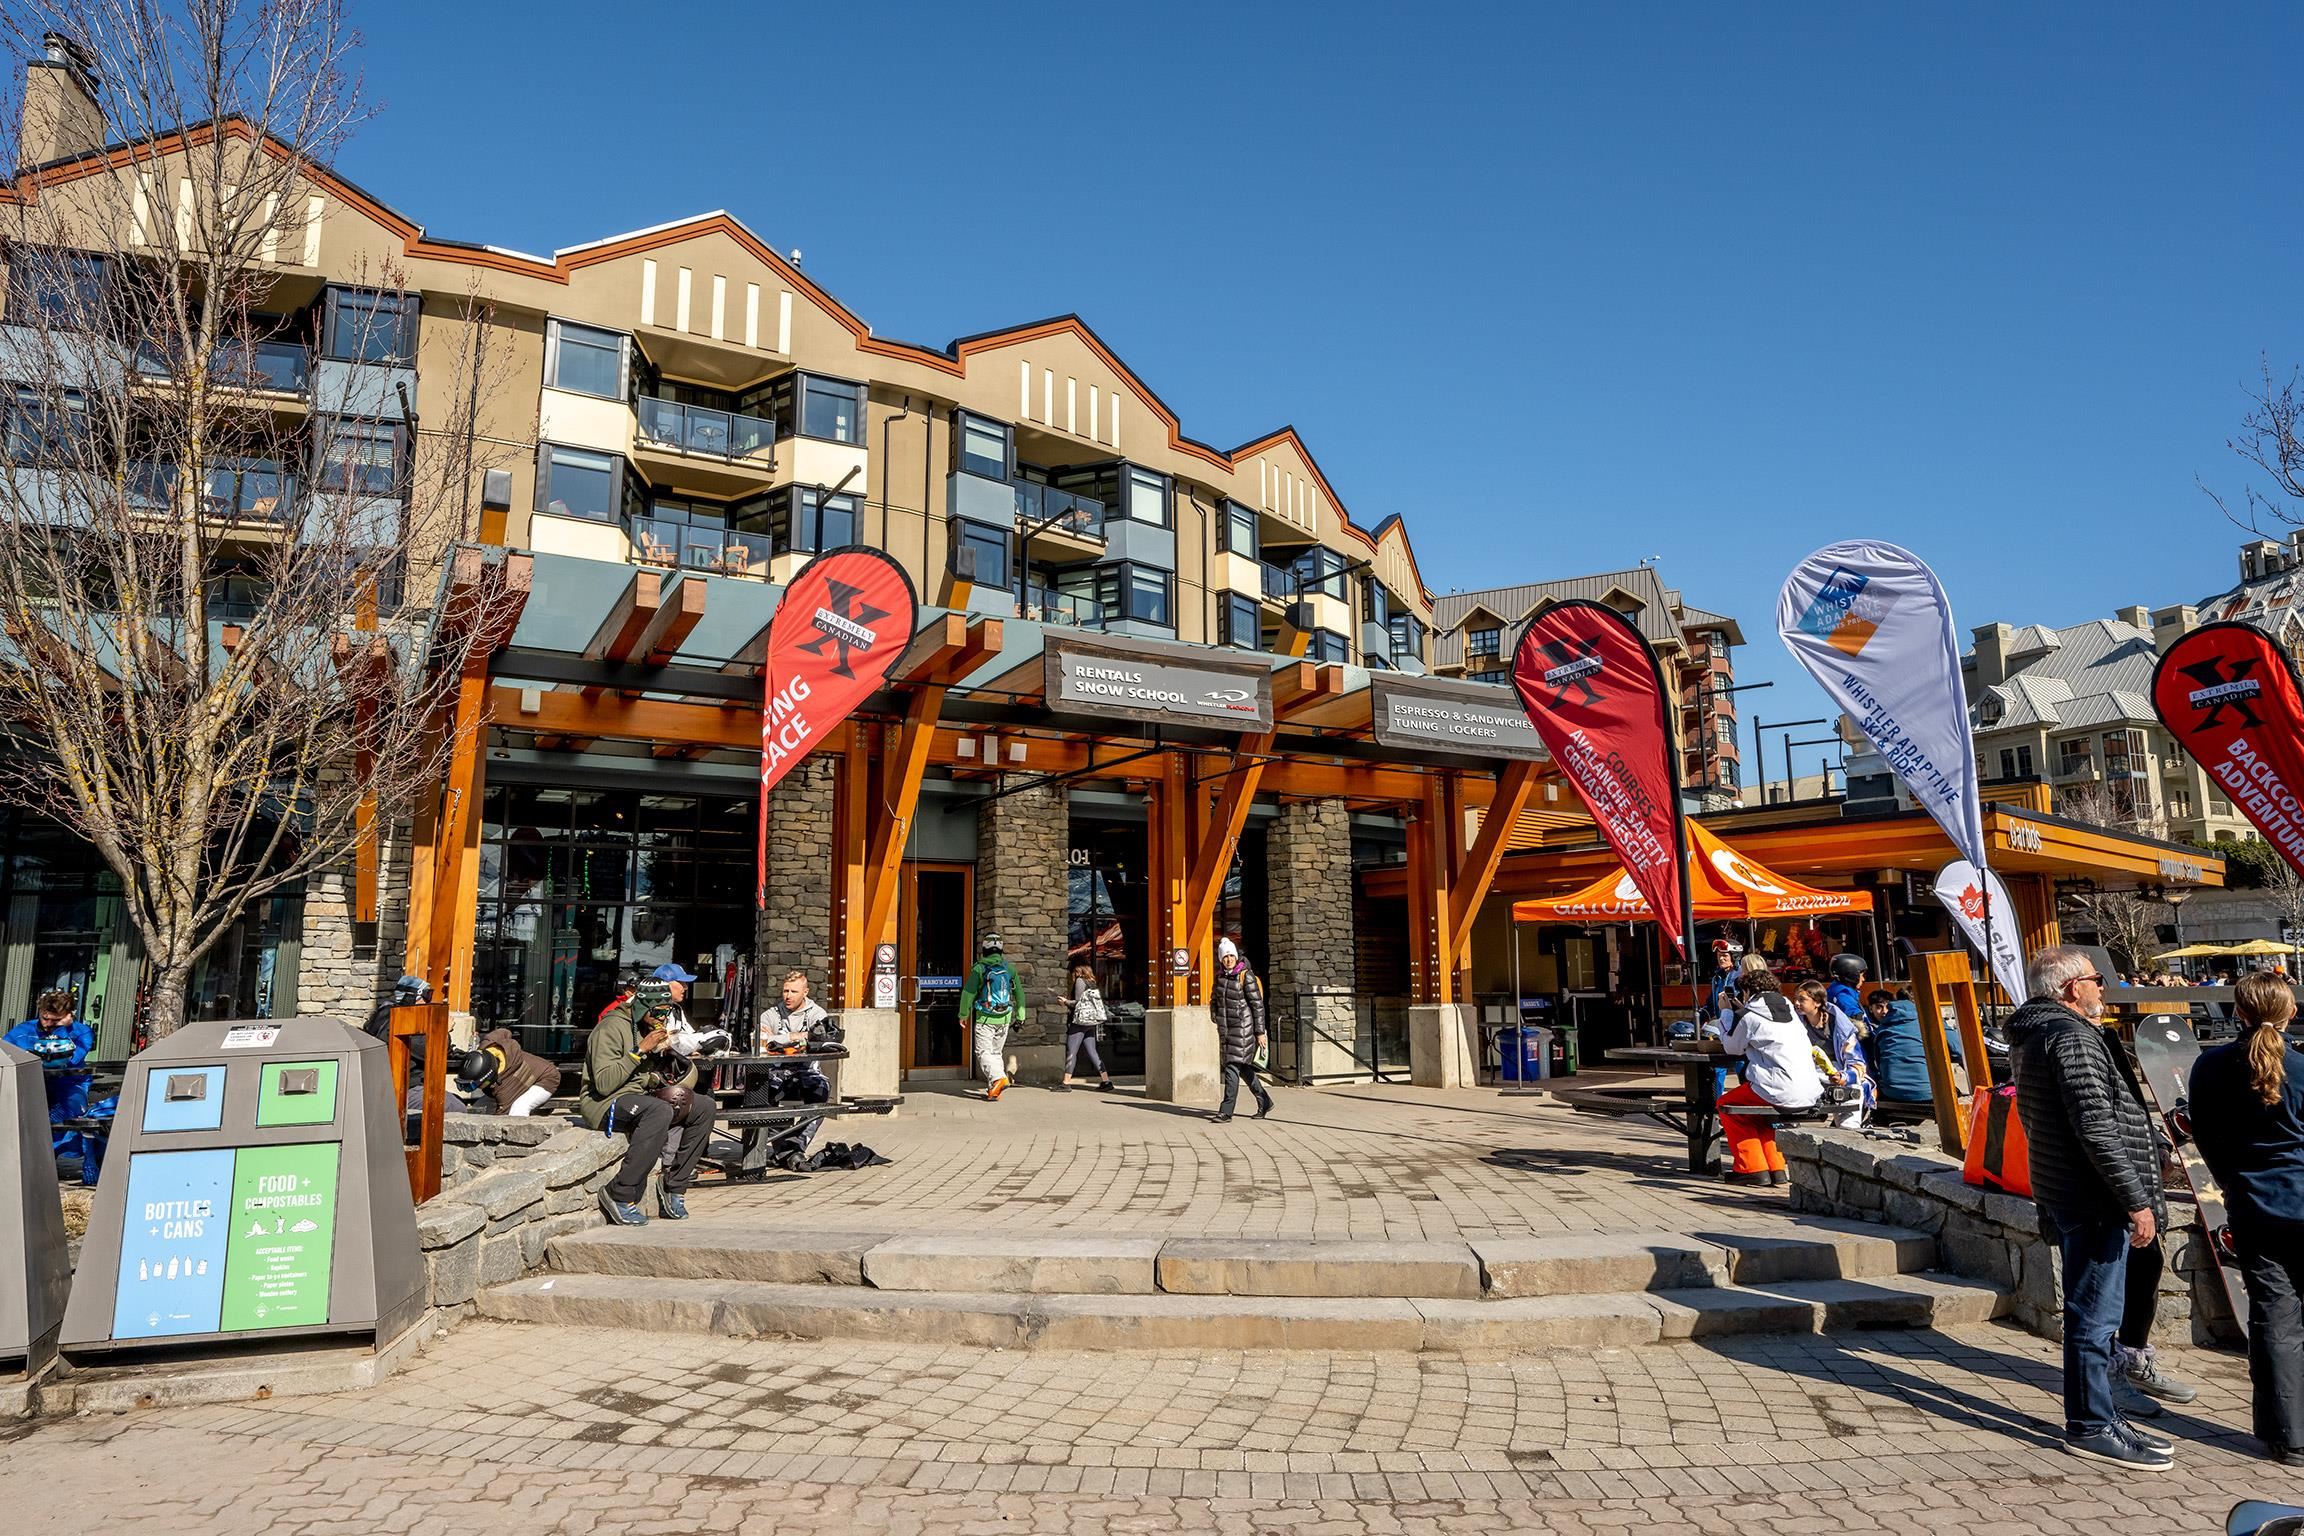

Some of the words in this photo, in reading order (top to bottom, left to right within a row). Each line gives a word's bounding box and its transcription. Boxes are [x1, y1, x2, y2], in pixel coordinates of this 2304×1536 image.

[815, 620, 868, 649] CANADIAN
[817, 610, 874, 640] EXTREMELY
[1075, 666, 1142, 684] RENTALS
[1549, 666, 1600, 688] CANADIAN
[1075, 681, 1124, 698] SNOW
[1128, 687, 1188, 705] SCHOOL
[1394, 704, 1449, 720] ESPRESSO
[1452, 711, 1461, 721] &
[1464, 712, 1534, 730] SANDWICHES
[1394, 718, 1439, 732] TUNING
[1449, 725, 1497, 738] LOCKERS
[1842, 674, 1901, 739] WHISTLER
[1897, 737, 1960, 805] ADAPTIVE
[1860, 716, 1882, 737] SKI
[1877, 736, 1889, 749] &
[1887, 747, 1917, 778] RIDE
[1605, 751, 1656, 818] COURSES
[2227, 738, 2304, 832] BACKCOU
[1564, 744, 1614, 817] CREVASSE
[1608, 813, 1652, 873] RESCUE
[1568, 729, 1631, 813] AVALANCHE
[1625, 810, 1670, 867] SAFETY
[258, 1174, 297, 1194] FOOD
[301, 1177, 311, 1187] +
[145, 1199, 212, 1221] BOTTLES
[245, 1193, 322, 1211] COMPOSTABLES
[150, 1225, 159, 1237] +
[163, 1219, 205, 1240] CANS
